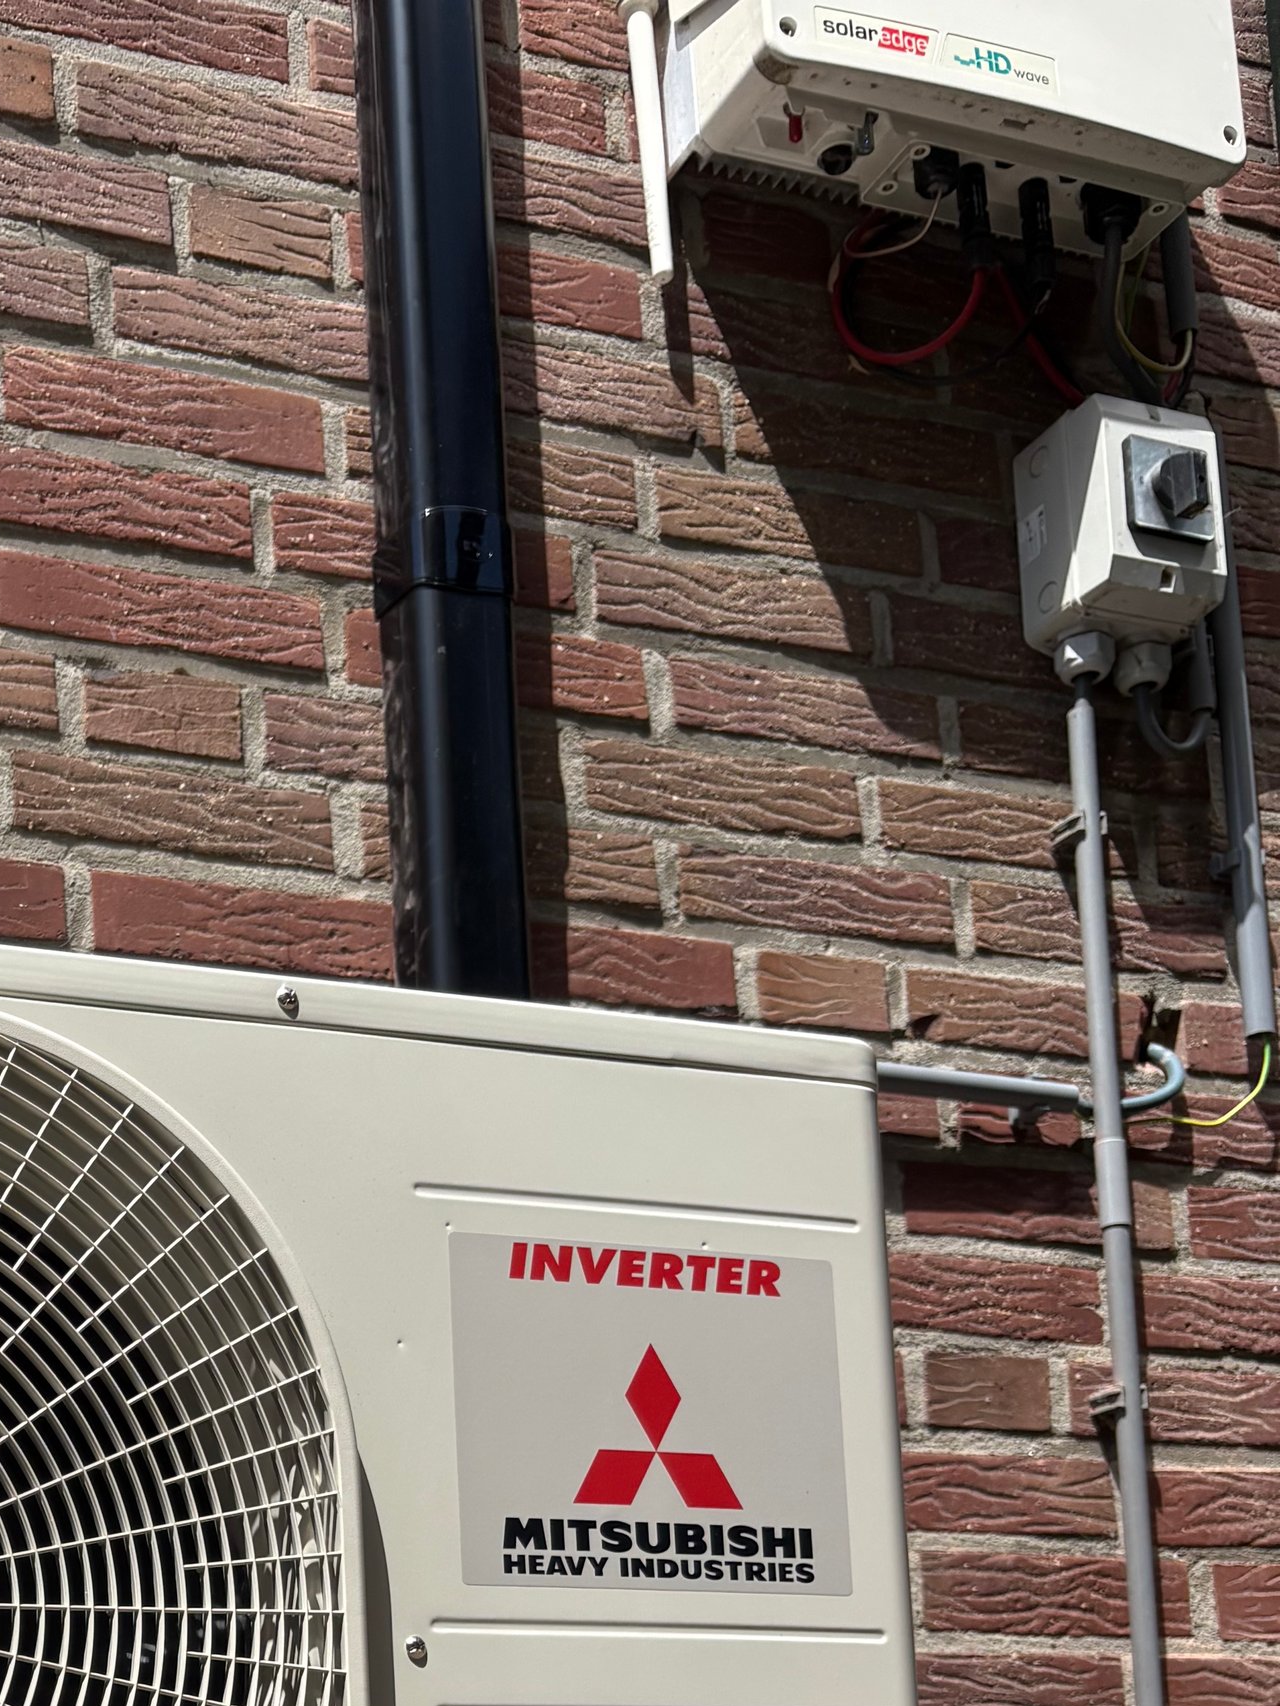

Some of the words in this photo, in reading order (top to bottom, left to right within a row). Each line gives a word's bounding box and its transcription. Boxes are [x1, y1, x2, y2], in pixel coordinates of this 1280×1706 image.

[823, 19, 929, 57] solaredge
[974, 47, 1012, 75] HD
[1014, 68, 1050, 86] wave
[509, 1242, 781, 1298] INVERTER
[502, 1517, 814, 1560] MITSUBISHI
[503, 1554, 609, 1576] HEAVY
[620, 1557, 815, 1584] INDUSTRIES
